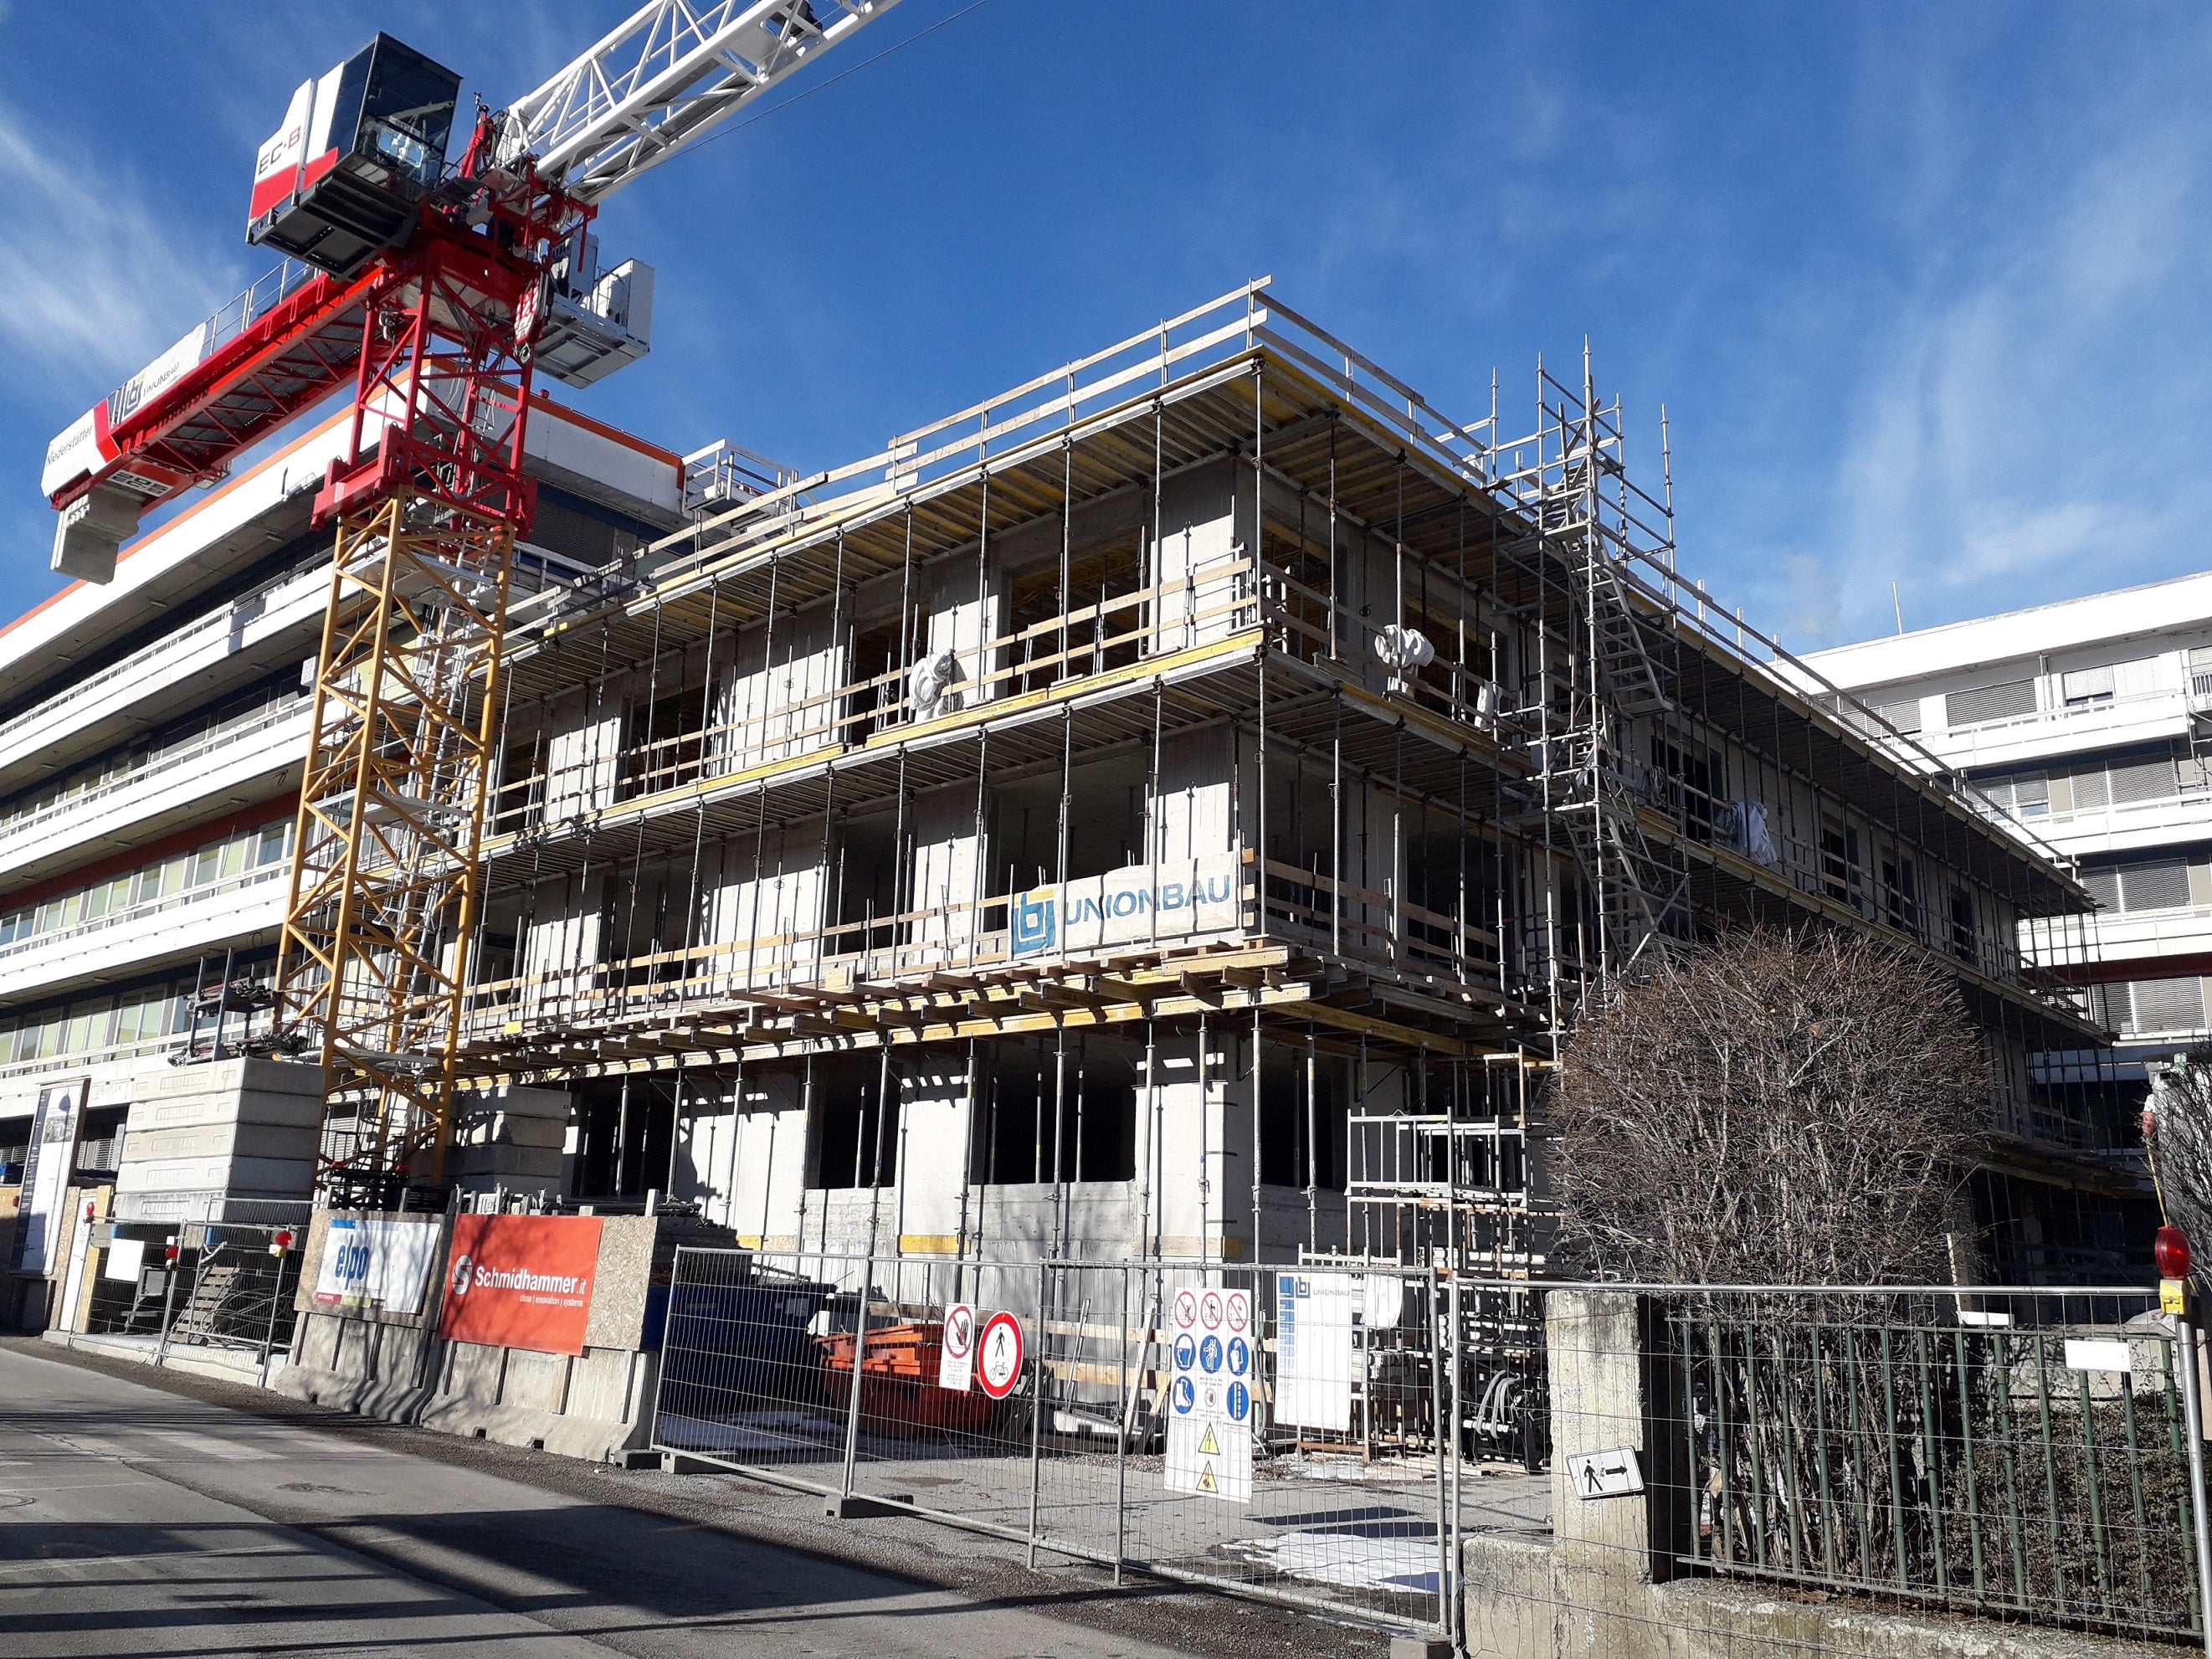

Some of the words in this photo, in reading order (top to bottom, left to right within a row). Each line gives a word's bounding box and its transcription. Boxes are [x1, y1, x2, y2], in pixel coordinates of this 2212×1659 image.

[1065, 874, 1231, 926] UNIONBAU
[335, 1235, 369, 1291] elpo
[475, 1266, 587, 1296] Schmidhammer.it
[1312, 1288, 1350, 1297] UNIONBAU
[535, 1294, 560, 1305] innovation
[562, 1297, 584, 1307] systems
